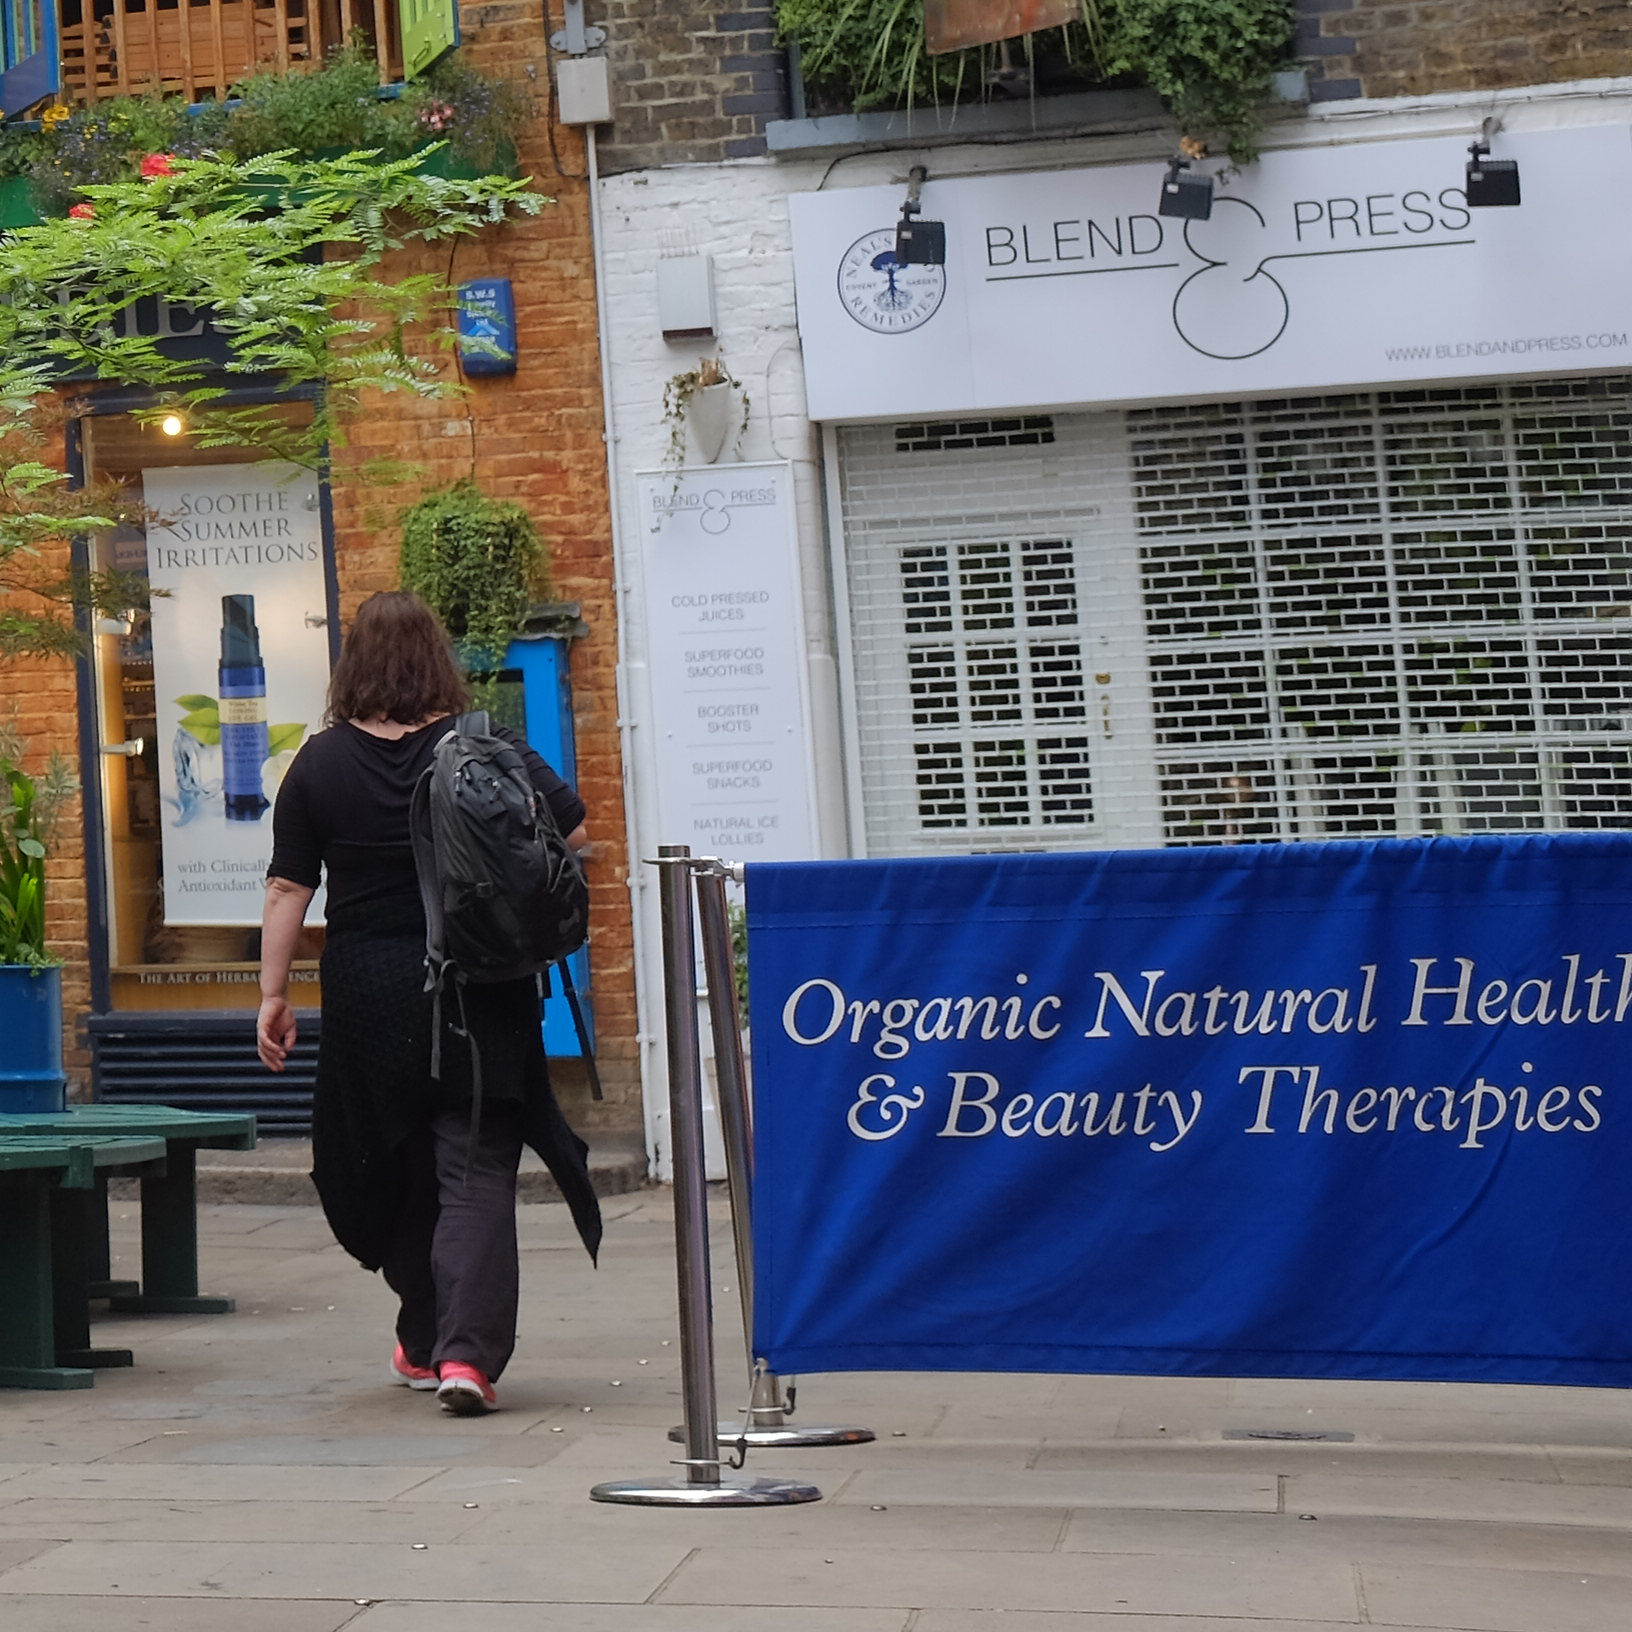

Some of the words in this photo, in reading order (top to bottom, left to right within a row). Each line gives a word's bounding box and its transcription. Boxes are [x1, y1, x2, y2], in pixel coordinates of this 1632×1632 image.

[985, 213, 1165, 268] BLEND
[1293, 186, 1474, 243] PRESS
[1384, 332, 1628, 362] WWW.BLENDANDPRESS.COM
[180, 490, 289, 516] SOOTHE
[730, 487, 777, 503] PRESS
[168, 517, 292, 543] SUMMER
[157, 540, 319, 569] IRRITATIONS
[671, 594, 708, 608] COLD
[711, 590, 770, 605] PRESSED
[698, 608, 745, 622] JUICES
[684, 646, 765, 663] SUPERFOOD
[687, 662, 765, 678] SMOOTHIES
[697, 703, 760, 718] BOOSTER
[707, 719, 752, 734] SHOTS
[692, 759, 773, 775] SUPERFOOD
[706, 776, 761, 790] SNACKS
[693, 816, 754, 832] NATURAL
[757, 815, 780, 829] ICE
[710, 832, 765, 846] LOLLIES
[177, 861, 206, 874] with
[178, 877, 257, 893] Antioxidant
[139, 972, 163, 984] THE
[166, 972, 191, 984] ART
[195, 972, 210, 984] OF
[216, 970, 262, 984] HERBA
[782, 973, 1063, 1060] Organic
[1084, 964, 1377, 1039] Natural
[848, 1074, 926, 1141] &
[937, 1071, 1204, 1153] Beauty
[1238, 1060, 1604, 1151] Therapies
